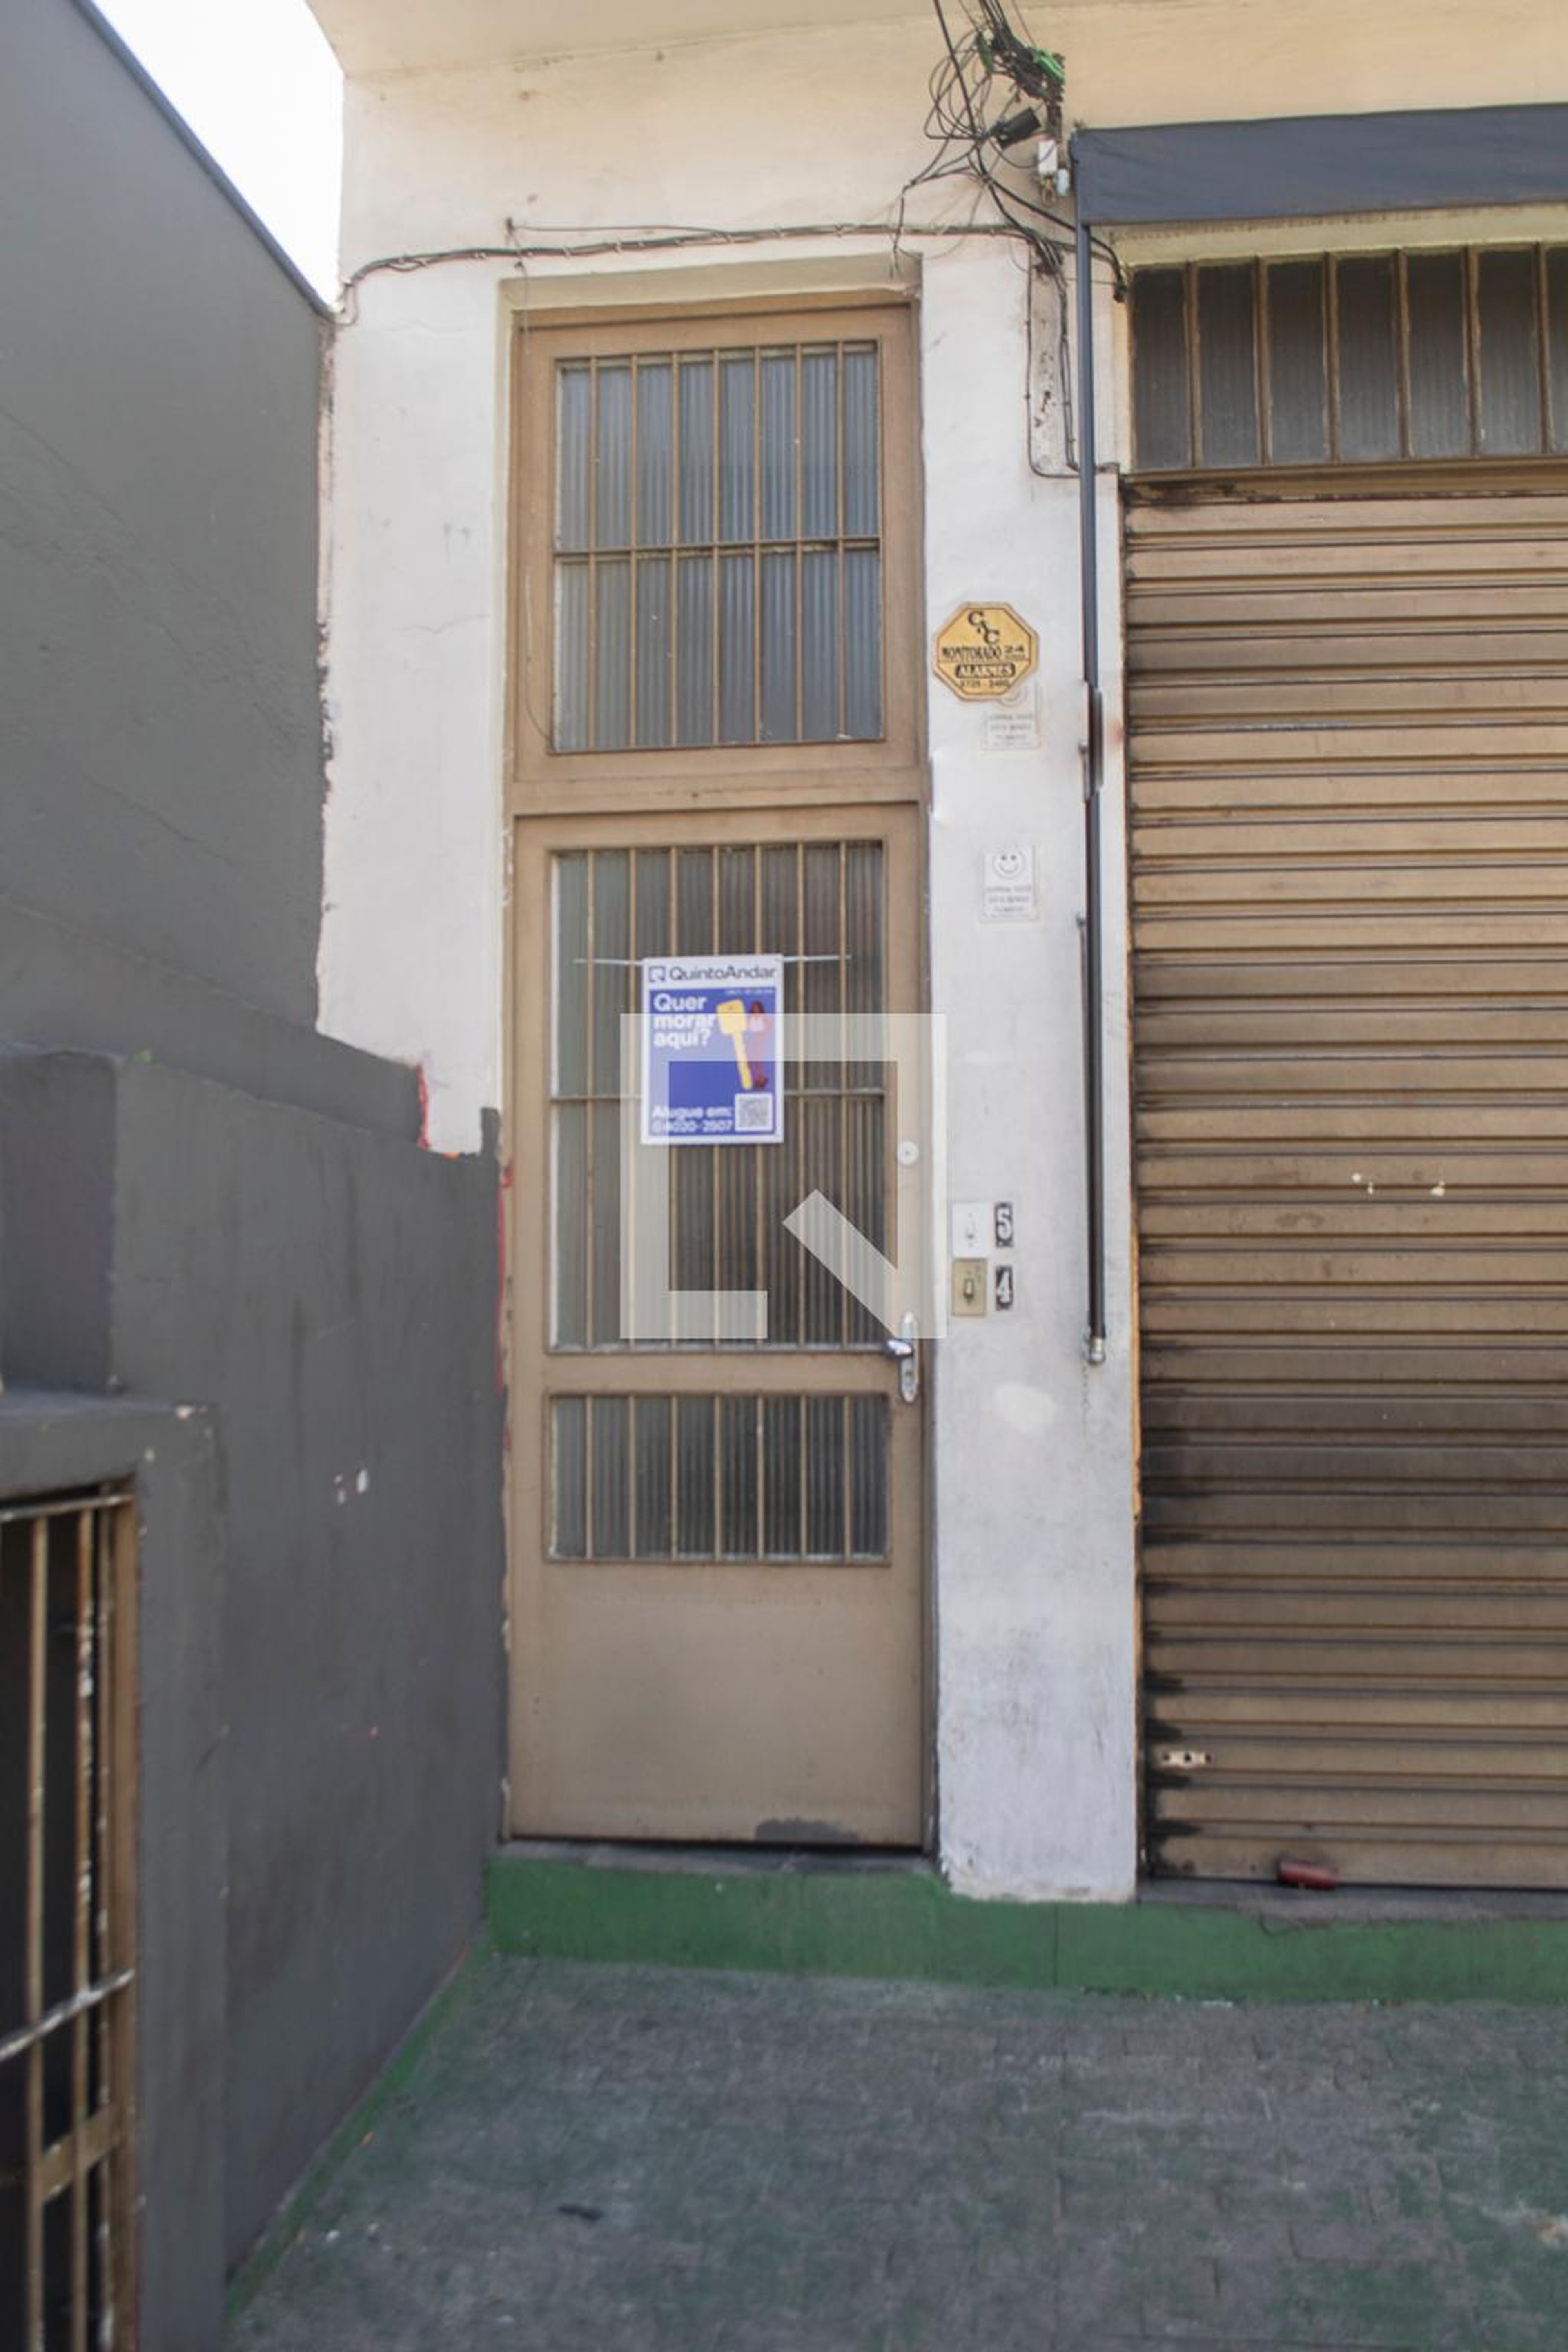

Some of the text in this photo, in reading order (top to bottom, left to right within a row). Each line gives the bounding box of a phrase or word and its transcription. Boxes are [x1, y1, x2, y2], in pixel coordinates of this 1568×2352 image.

[670, 965, 775, 981] QuintoAndar
[653, 993, 708, 1012] Quer
[653, 1014, 716, 1029] morar
[653, 1028, 712, 1049] aqui?
[997, 1207, 1012, 1240] 5
[996, 1272, 1012, 1303] 4
